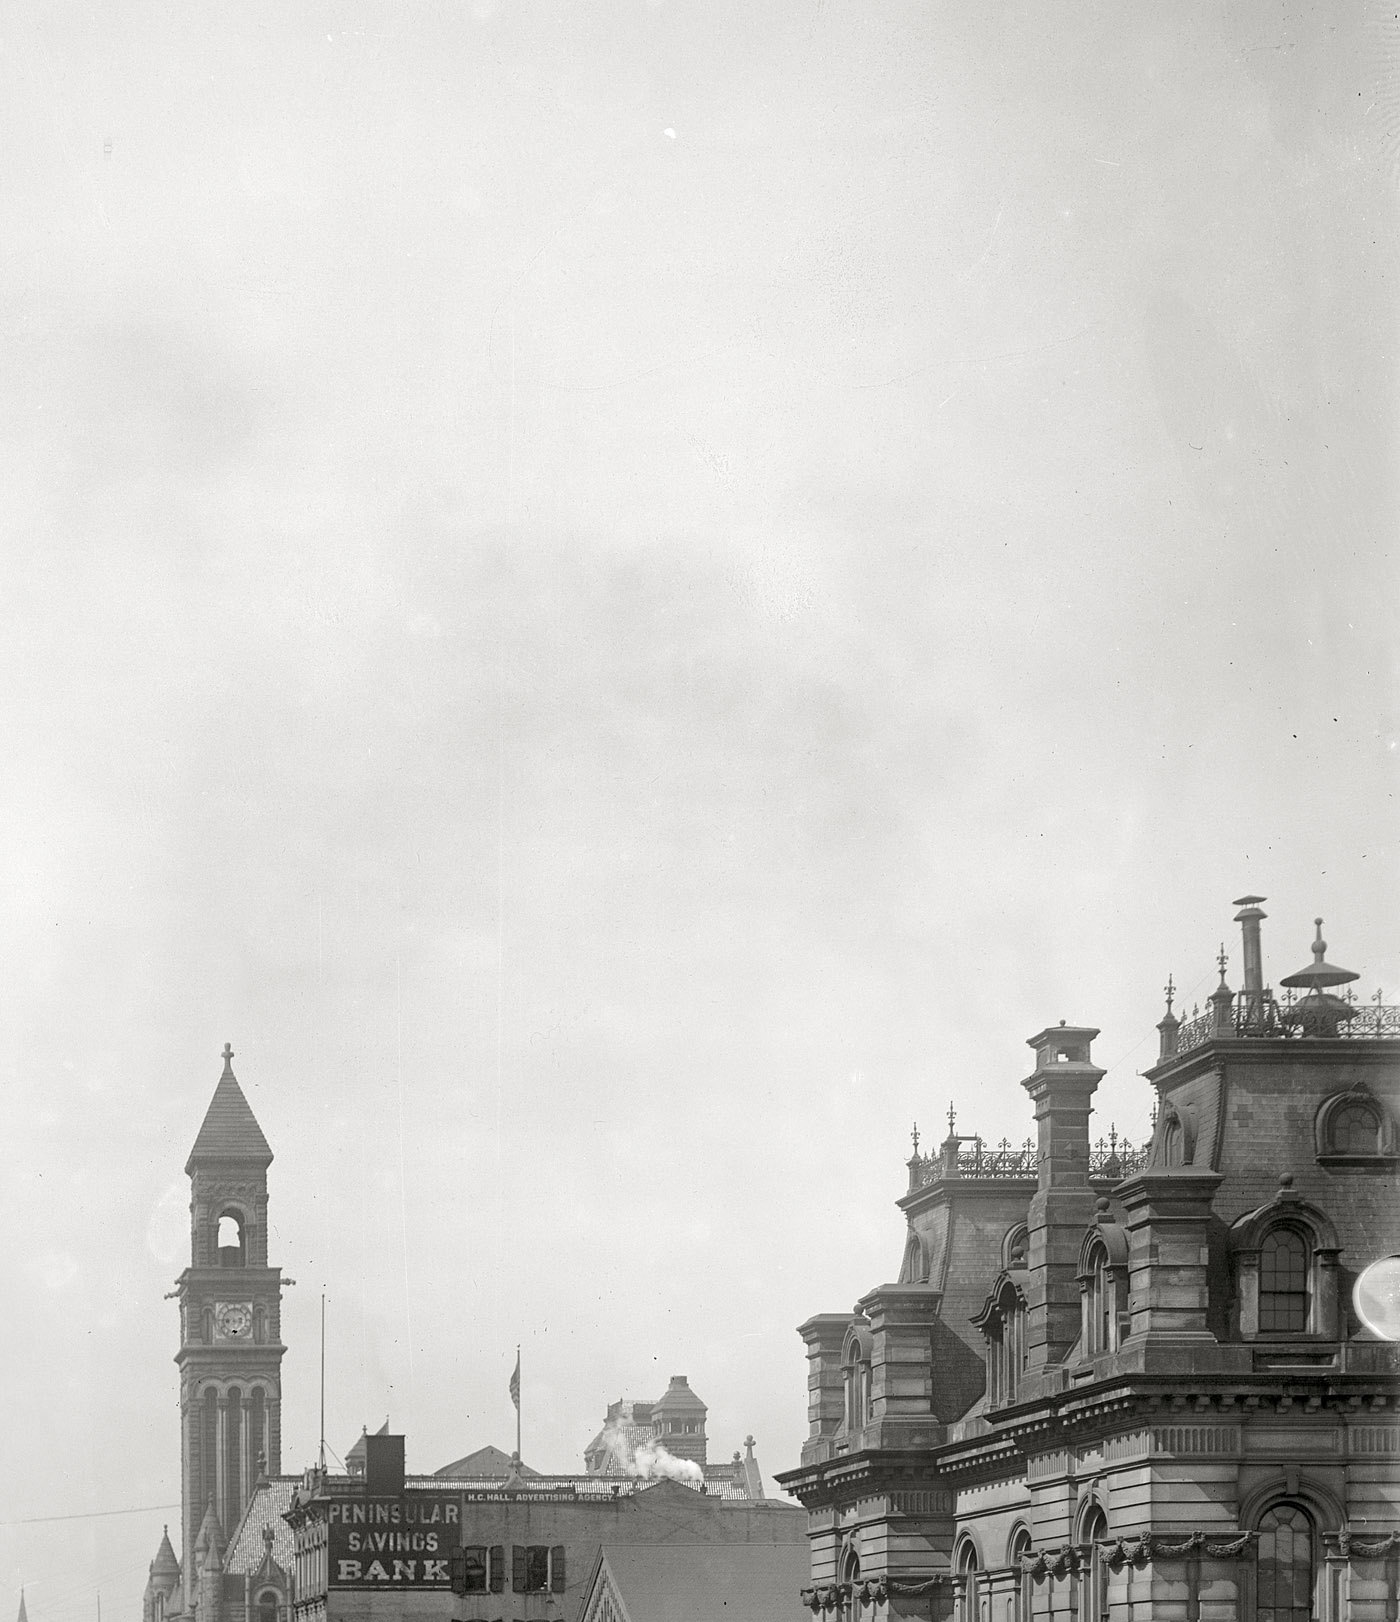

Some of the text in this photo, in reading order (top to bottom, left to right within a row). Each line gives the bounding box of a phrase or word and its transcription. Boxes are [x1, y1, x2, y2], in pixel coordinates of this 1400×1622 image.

[515, 1493, 574, 1501] ADVERTISING
[329, 1503, 458, 1525] PENINSULAR
[348, 1532, 438, 1551] SAVINGS
[338, 1559, 450, 1580] BANK
